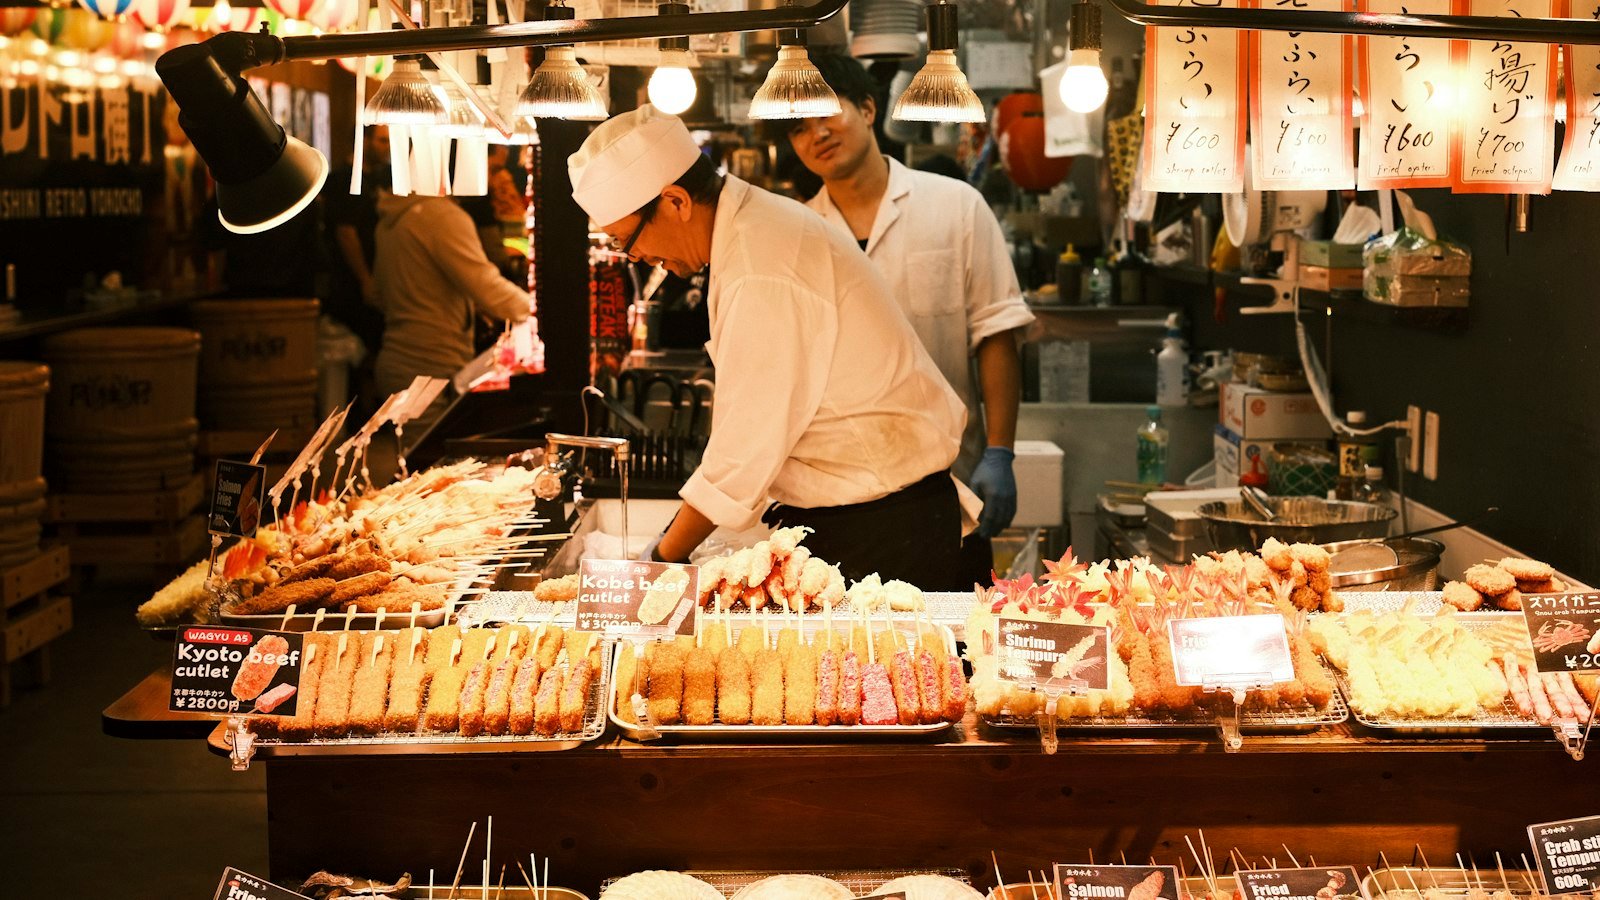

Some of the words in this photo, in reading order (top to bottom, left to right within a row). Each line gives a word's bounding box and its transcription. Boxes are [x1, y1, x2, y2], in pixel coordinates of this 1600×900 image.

[1166, 122, 1220, 153] ¥600
[1384, 123, 1434, 153] ¥600
[1476, 127, 1525, 159] ¥700
[1376, 158, 1403, 176] Fried
[1471, 162, 1497, 176] Fried
[599, 281, 617, 338] STEAK
[582, 574, 635, 590] Kobe
[639, 576, 687, 593] beef
[580, 592, 630, 604] cutlet
[1529, 595, 1600, 608] ズワイガニ
[188, 632, 229, 641] WAGYU
[233, 633, 248, 643] A5
[1005, 633, 1056, 651] Shrimp
[178, 643, 242, 663] Kyoto
[249, 646, 300, 667] beef
[175, 663, 230, 679] cutlet
[173, 688, 225, 698] 京都牛の牛カツ
[1544, 838, 1581, 855] Crab
[1068, 883, 1125, 898] Salmon
[1251, 883, 1290, 896] Fried
